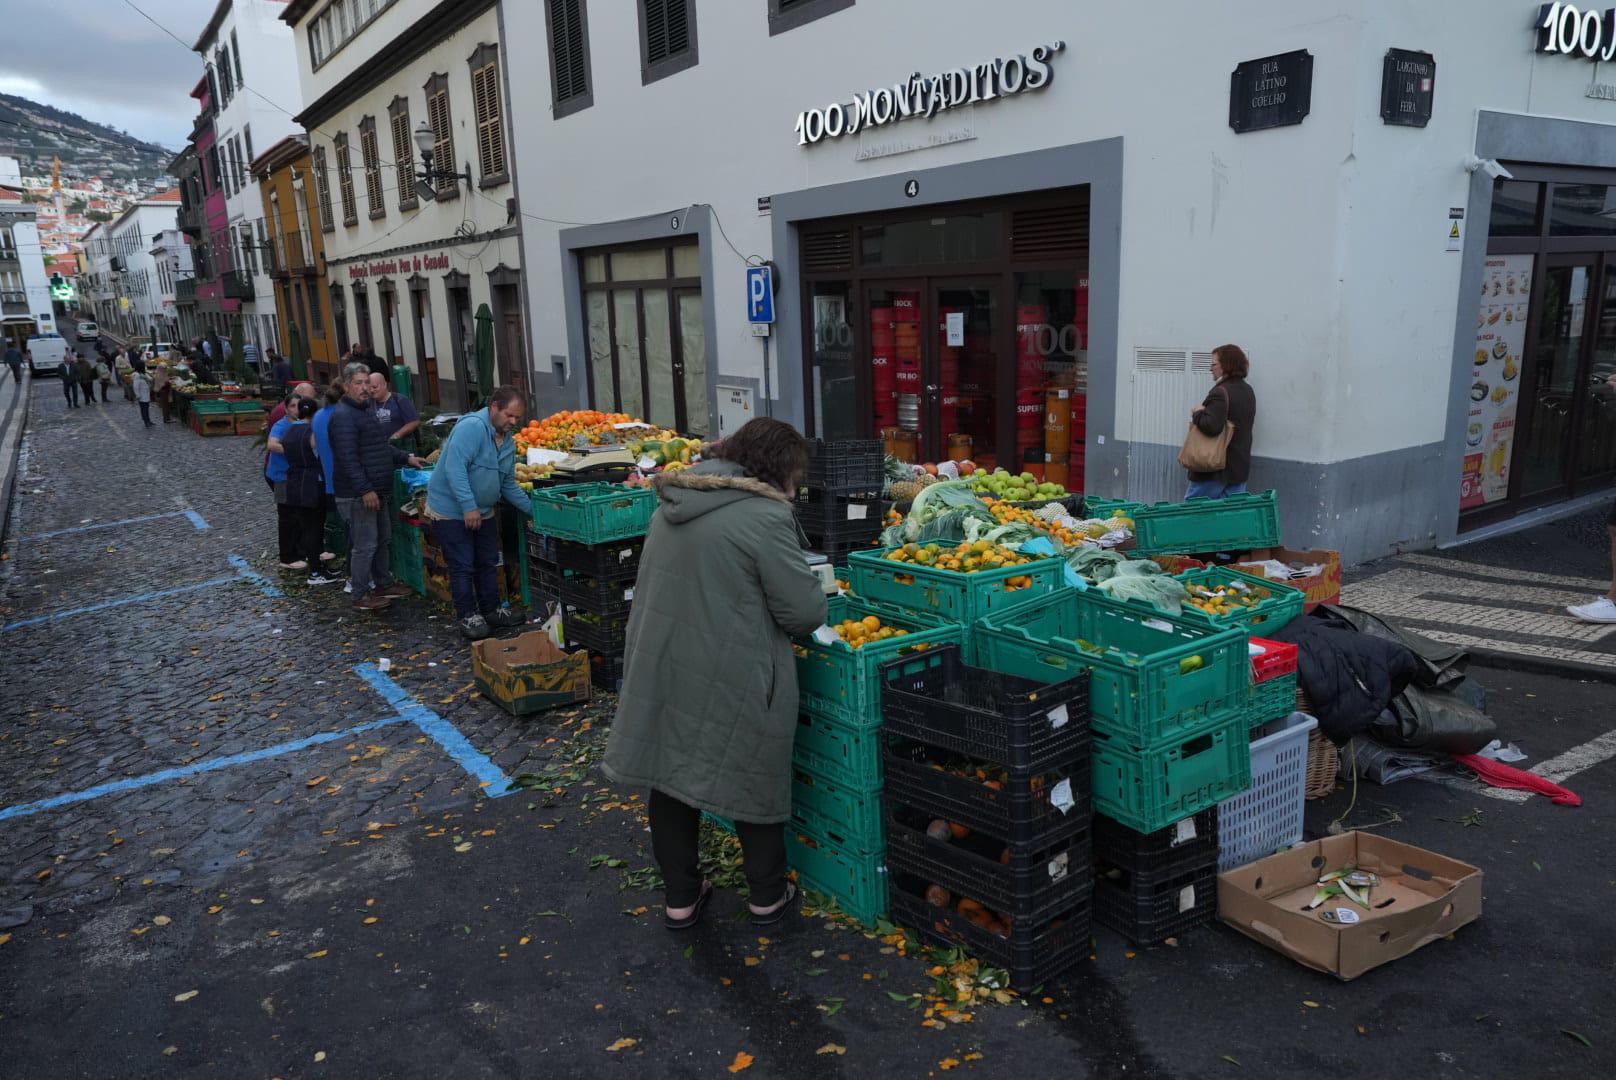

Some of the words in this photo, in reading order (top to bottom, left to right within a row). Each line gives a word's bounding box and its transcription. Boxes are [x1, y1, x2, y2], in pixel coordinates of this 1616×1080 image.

[1543, 1, 1601, 57] 100
[1262, 61, 1278, 74] RUA
[1396, 60, 1428, 75] LARGUINHO
[1255, 75, 1287, 92] LATINO
[1406, 82, 1414, 93] DA
[794, 102, 844, 146] 100
[846, 44, 1055, 134] MONTADITOS
[1252, 92, 1286, 108] COELHO
[1400, 101, 1416, 113] FEIRA
[908, 181, 916, 196] 4
[752, 273, 765, 318] P
